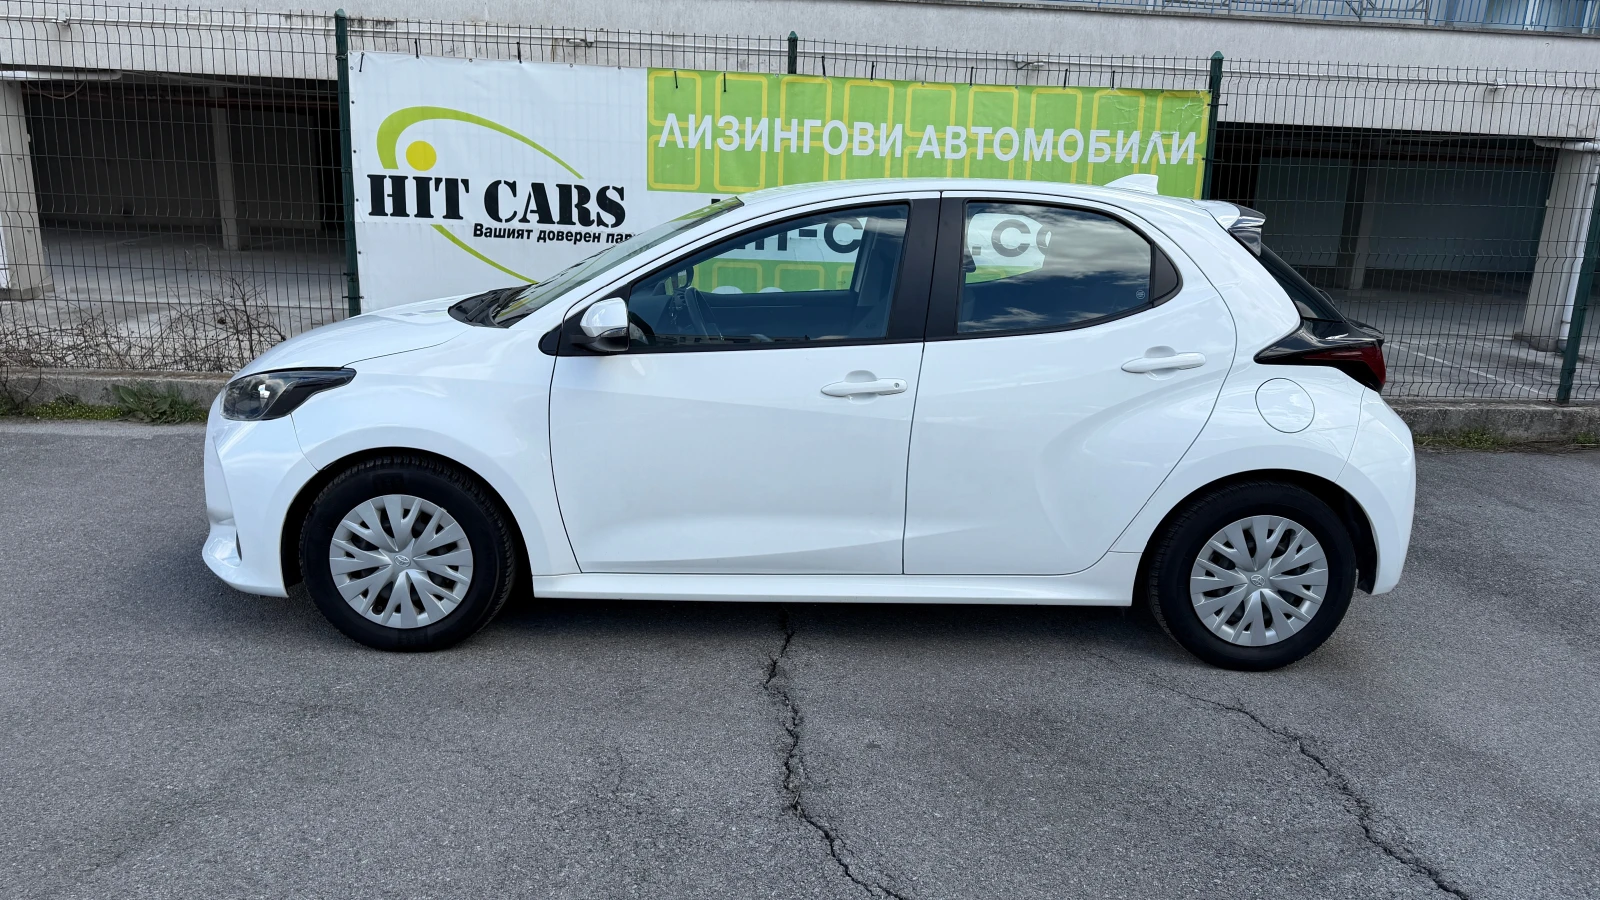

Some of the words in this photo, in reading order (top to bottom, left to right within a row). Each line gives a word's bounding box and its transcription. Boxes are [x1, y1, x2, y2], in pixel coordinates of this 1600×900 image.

[658, 112, 903, 158] ЛИЗИНГОВИ
[916, 124, 1196, 165] АВТОМОБИЛИ
[367, 173, 469, 221] HIT
[483, 179, 626, 229] CARS
[473, 223, 533, 240] Вашият
[536, 229, 601, 245] доверен
